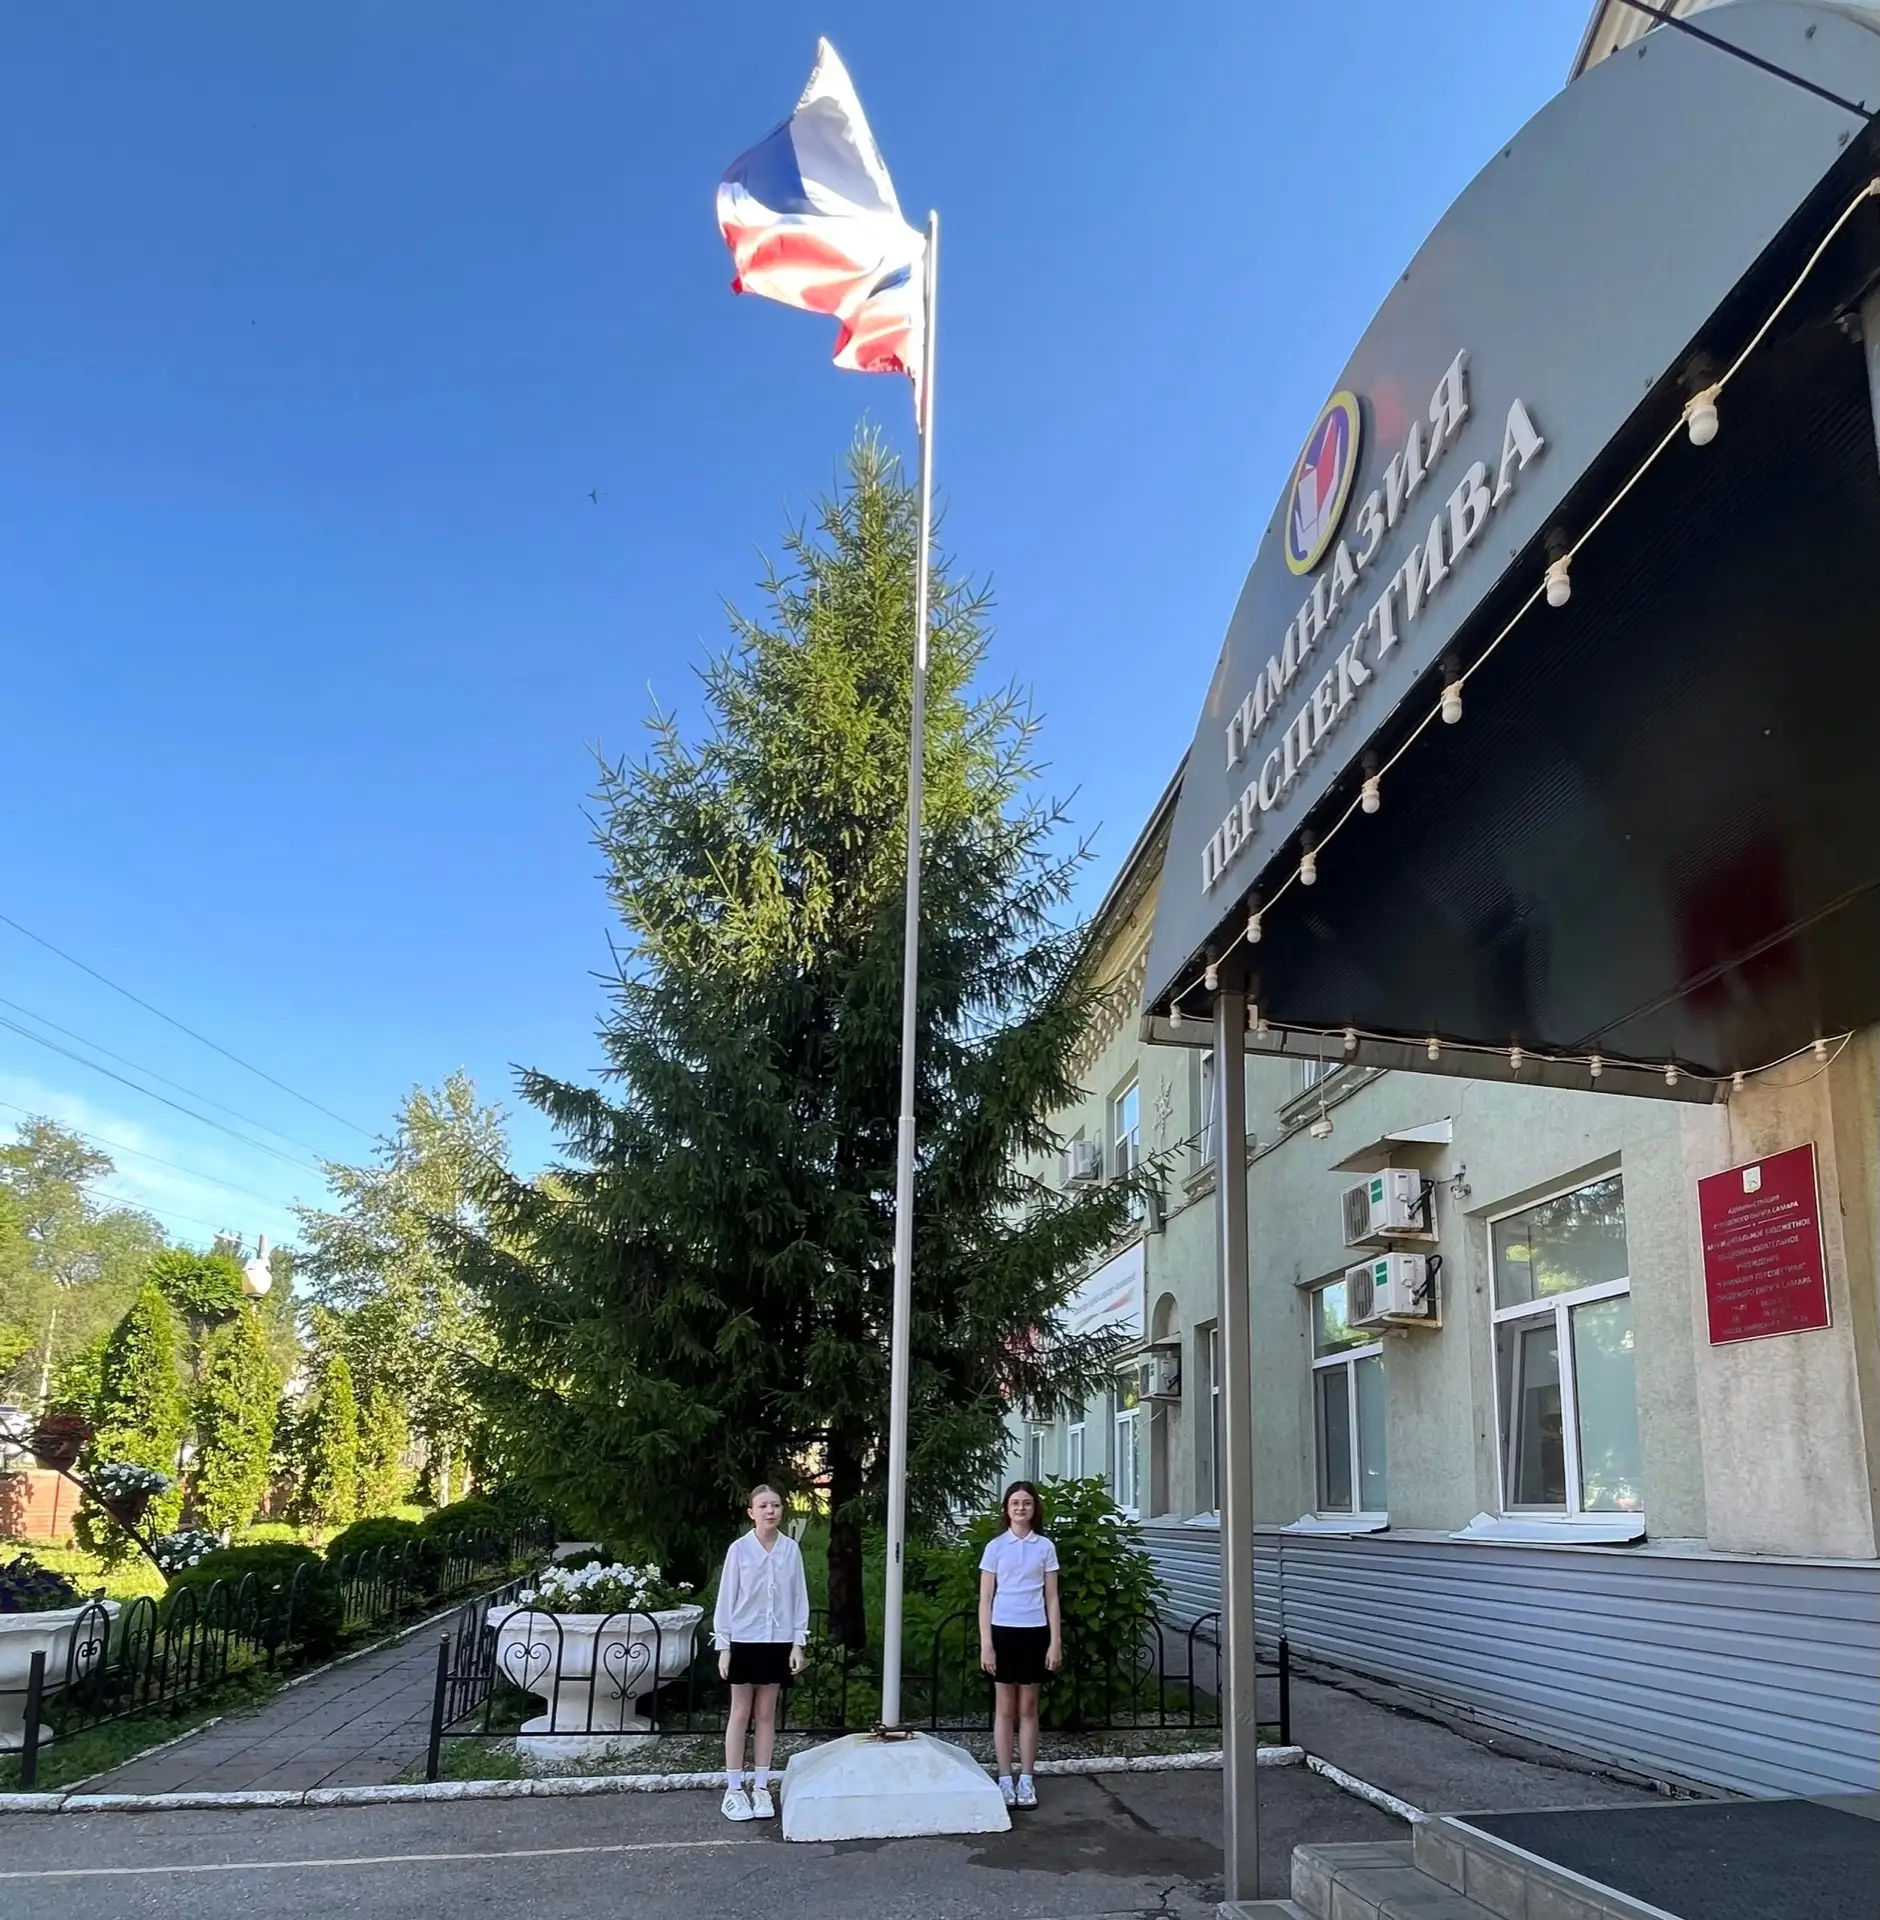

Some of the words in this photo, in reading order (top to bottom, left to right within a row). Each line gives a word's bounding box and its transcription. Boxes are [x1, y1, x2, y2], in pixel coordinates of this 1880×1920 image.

[1225, 347, 1471, 772] ГИМНАЗИЯ
[1200, 398, 1545, 895] ПЕРСПЕКТИВА
[1772, 1201, 1799, 1213] САМАРА
[1718, 1234, 1799, 1261] ЕОБРАЗОВАТЕЛЬНОЕ
[1781, 1276, 1812, 1289] САМАРА
